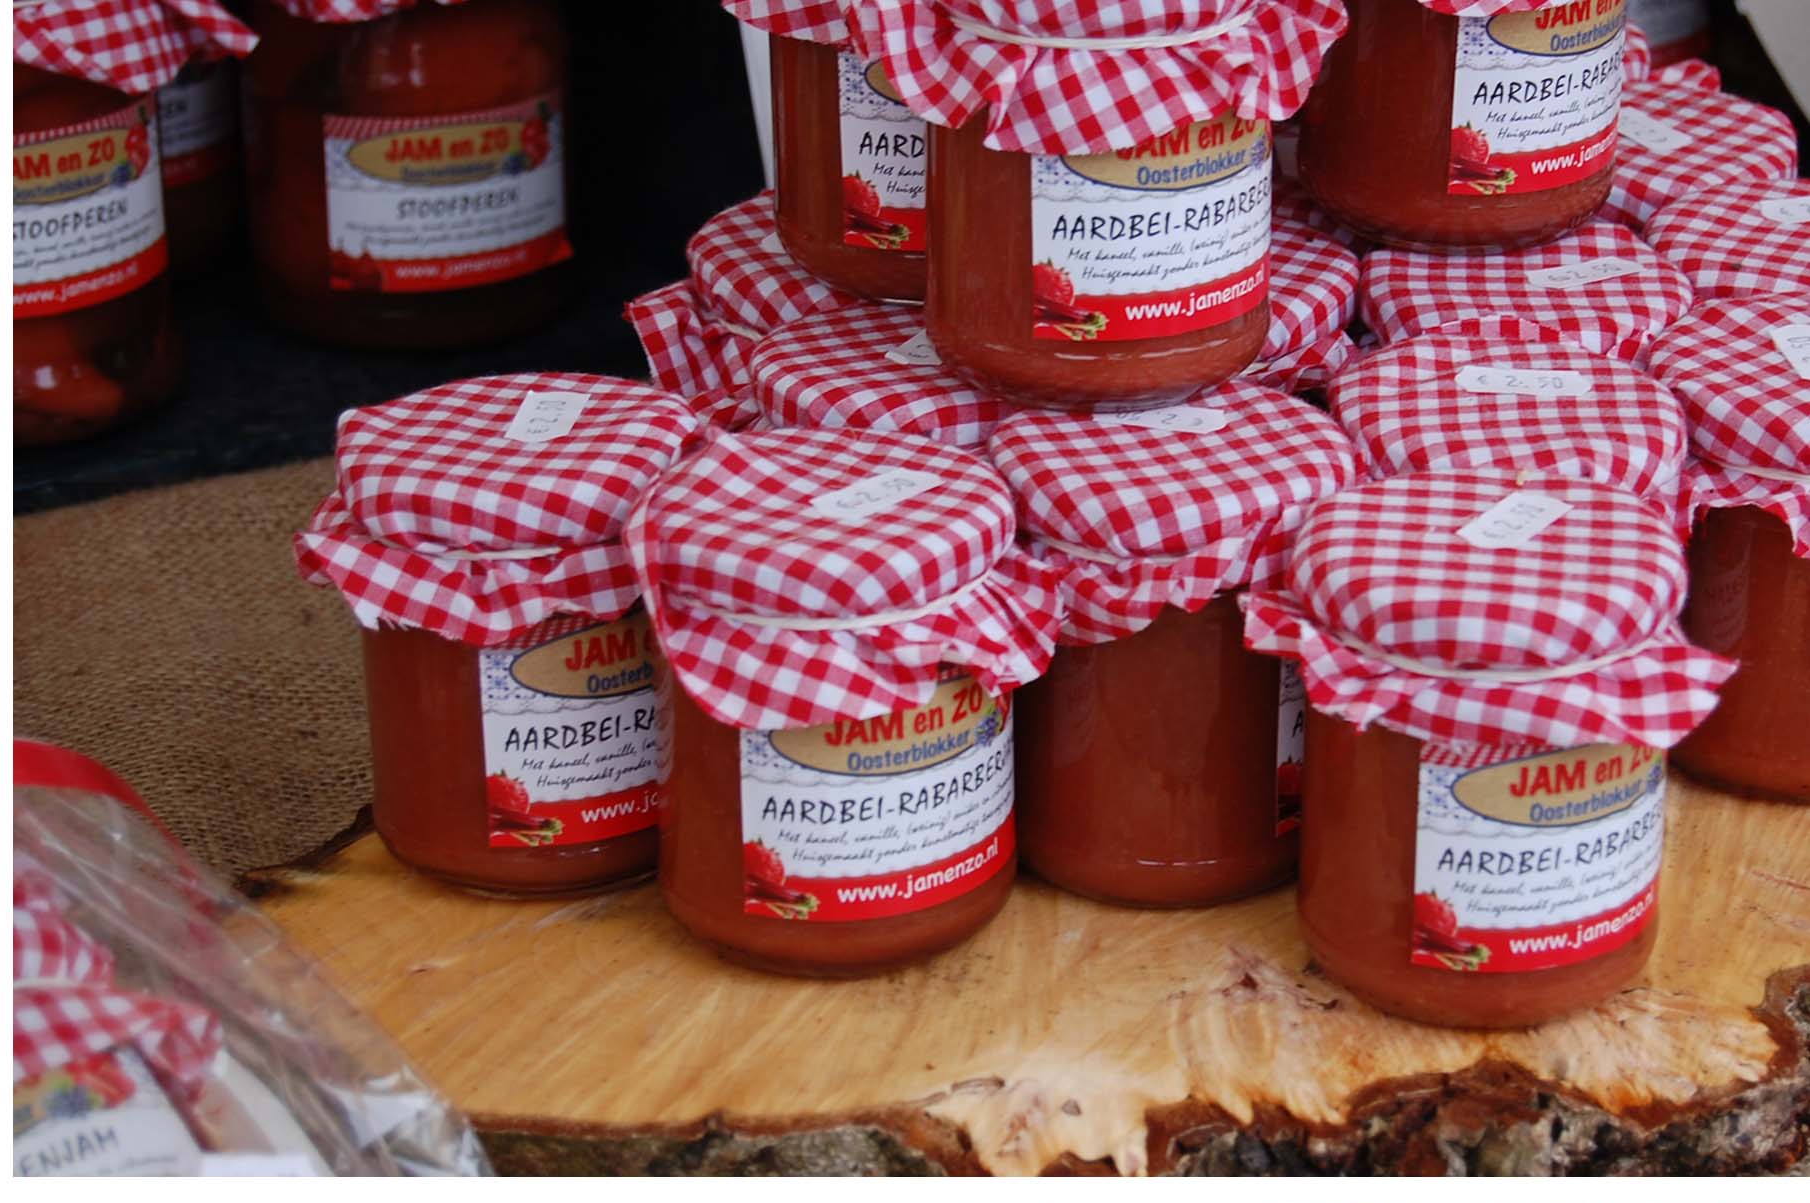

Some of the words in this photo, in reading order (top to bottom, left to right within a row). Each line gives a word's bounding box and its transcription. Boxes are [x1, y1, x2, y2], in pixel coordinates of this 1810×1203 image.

[1534, 1, 1591, 30] JAM
[385, 136, 442, 164] JAM
[449, 139, 474, 158] en
[479, 127, 510, 155] ZO
[859, 131, 926, 158] AARD
[1197, 121, 1226, 150] en
[13, 152, 51, 181] AM
[57, 152, 83, 174] en
[898, 163, 926, 178] kane
[1136, 148, 1247, 185] Oosterblokker
[886, 180, 926, 199] Huisge
[1124, 263, 1266, 321] www.jamenzo.nl
[564, 627, 639, 672] JAM
[586, 661, 655, 694] Oosterb
[824, 708, 904, 747] JAM
[913, 703, 945, 736] en
[952, 681, 984, 724] ZO
[846, 728, 971, 772] Oosterblokker
[1509, 759, 1588, 798] JAM
[1594, 754, 1624, 784] en
[836, 836, 999, 904] www.jamenzo.nl
[1508, 887, 1655, 955] www.jamenzo.nl
